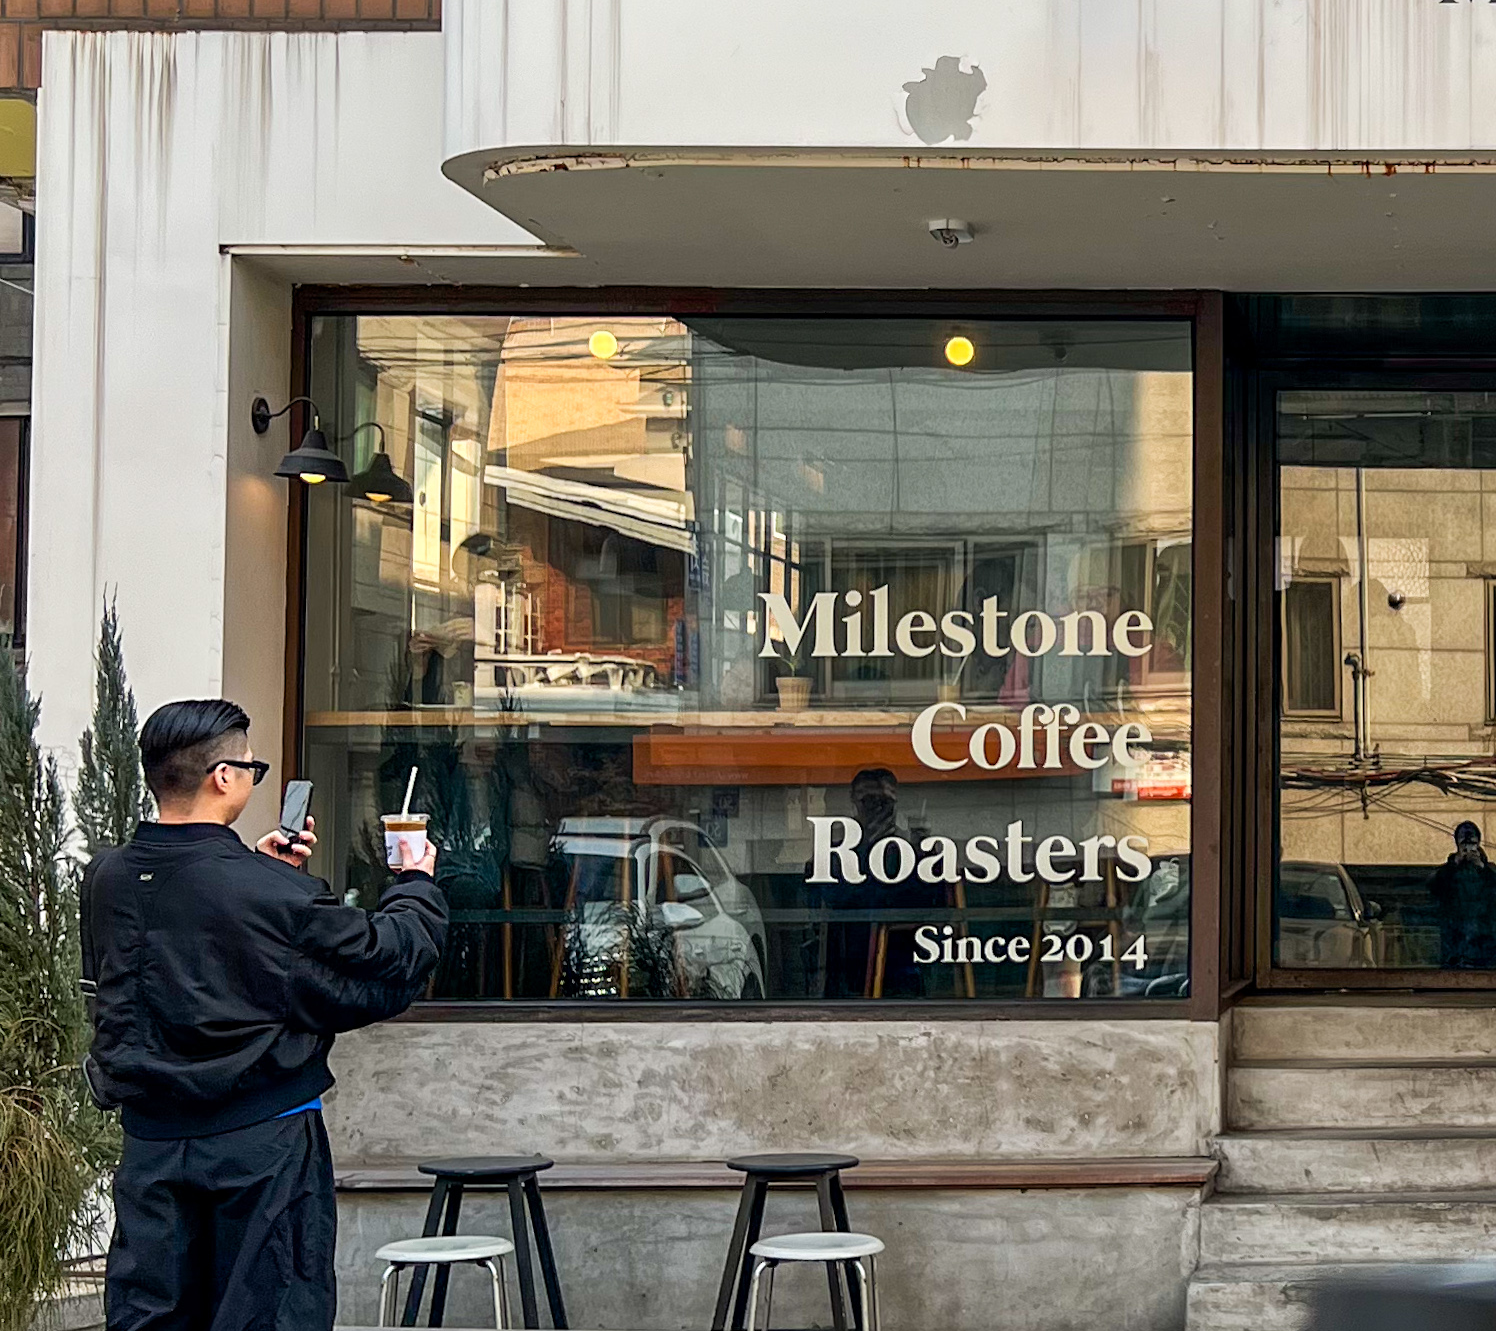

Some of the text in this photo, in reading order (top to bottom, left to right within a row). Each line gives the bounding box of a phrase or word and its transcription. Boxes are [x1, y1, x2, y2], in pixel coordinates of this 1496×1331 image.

[756, 584, 1154, 658] Milestone
[910, 701, 1154, 771] Coffee
[804, 815, 1153, 885] Roasters
[912, 925, 1149, 970] Since 2014
